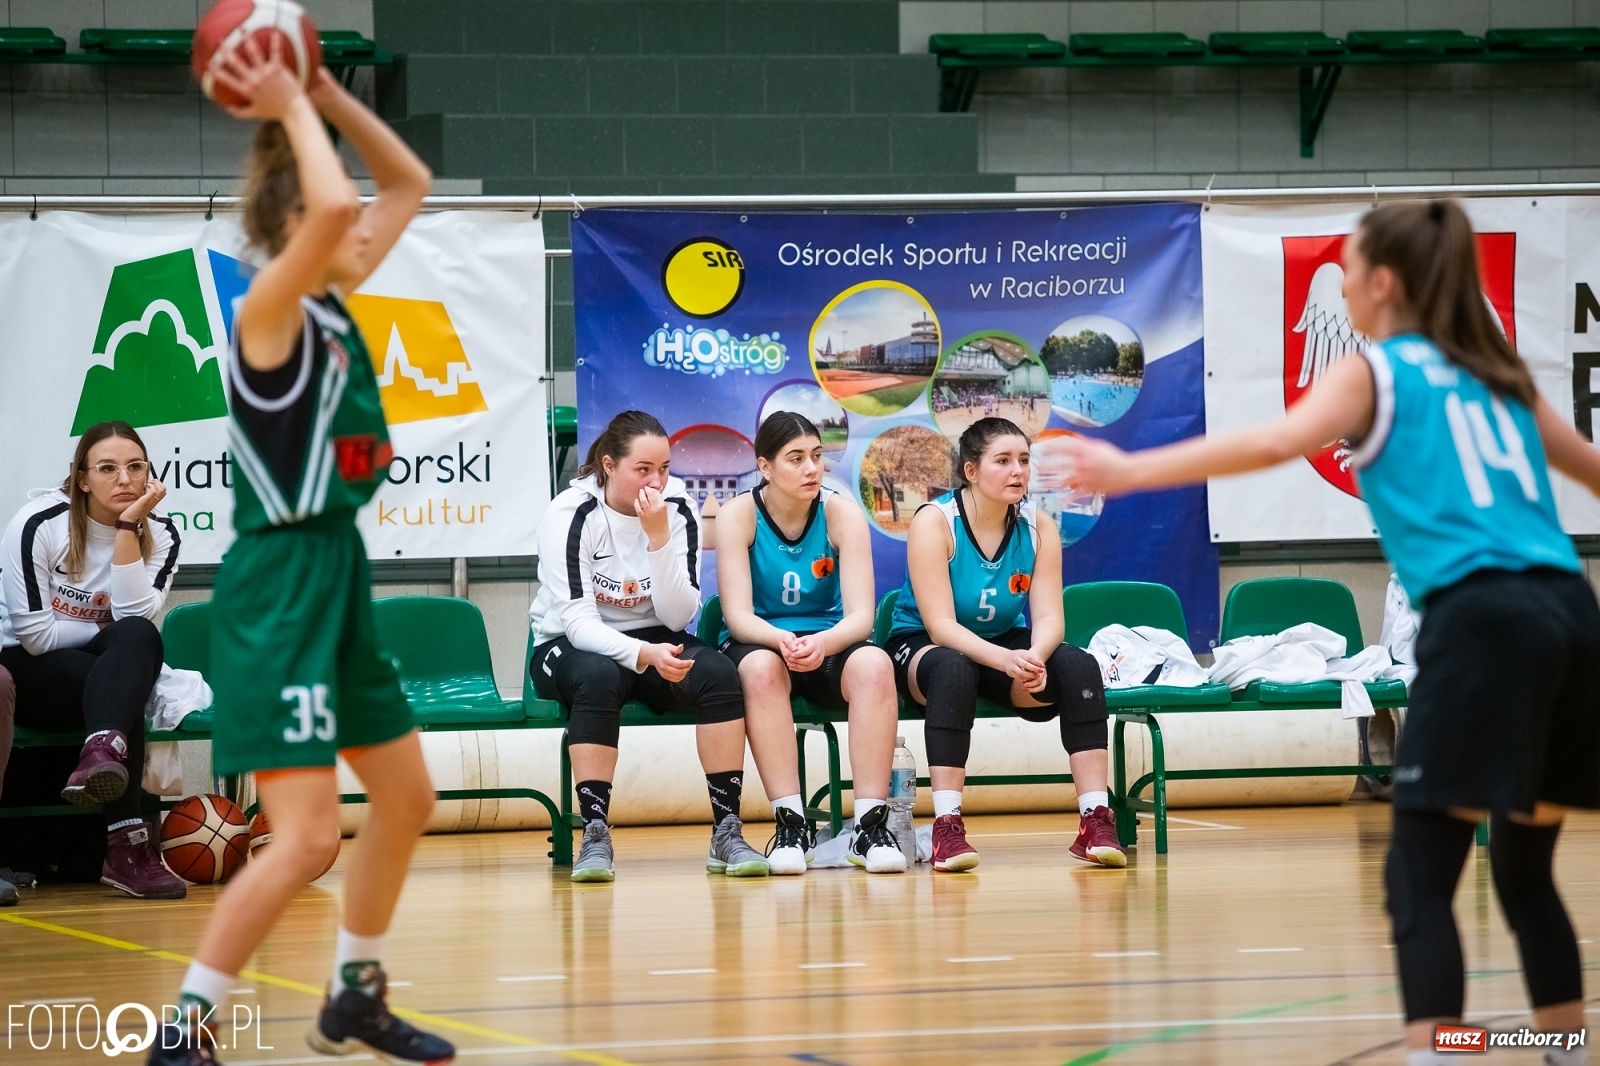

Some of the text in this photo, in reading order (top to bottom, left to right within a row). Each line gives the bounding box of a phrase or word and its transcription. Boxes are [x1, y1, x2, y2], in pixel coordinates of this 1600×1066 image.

[778, 236, 1127, 271] Ośrodek Sportu i Rekreacji
[970, 275, 1125, 299] w Raciborzu
[1445, 391, 1540, 508] 14
[378, 498, 492, 526] kultur
[58, 585, 92, 604] NOWY
[592, 574, 622, 593] NOWY
[781, 570, 801, 606] 8
[976, 587, 997, 622] 5
[281, 684, 337, 743] 35
